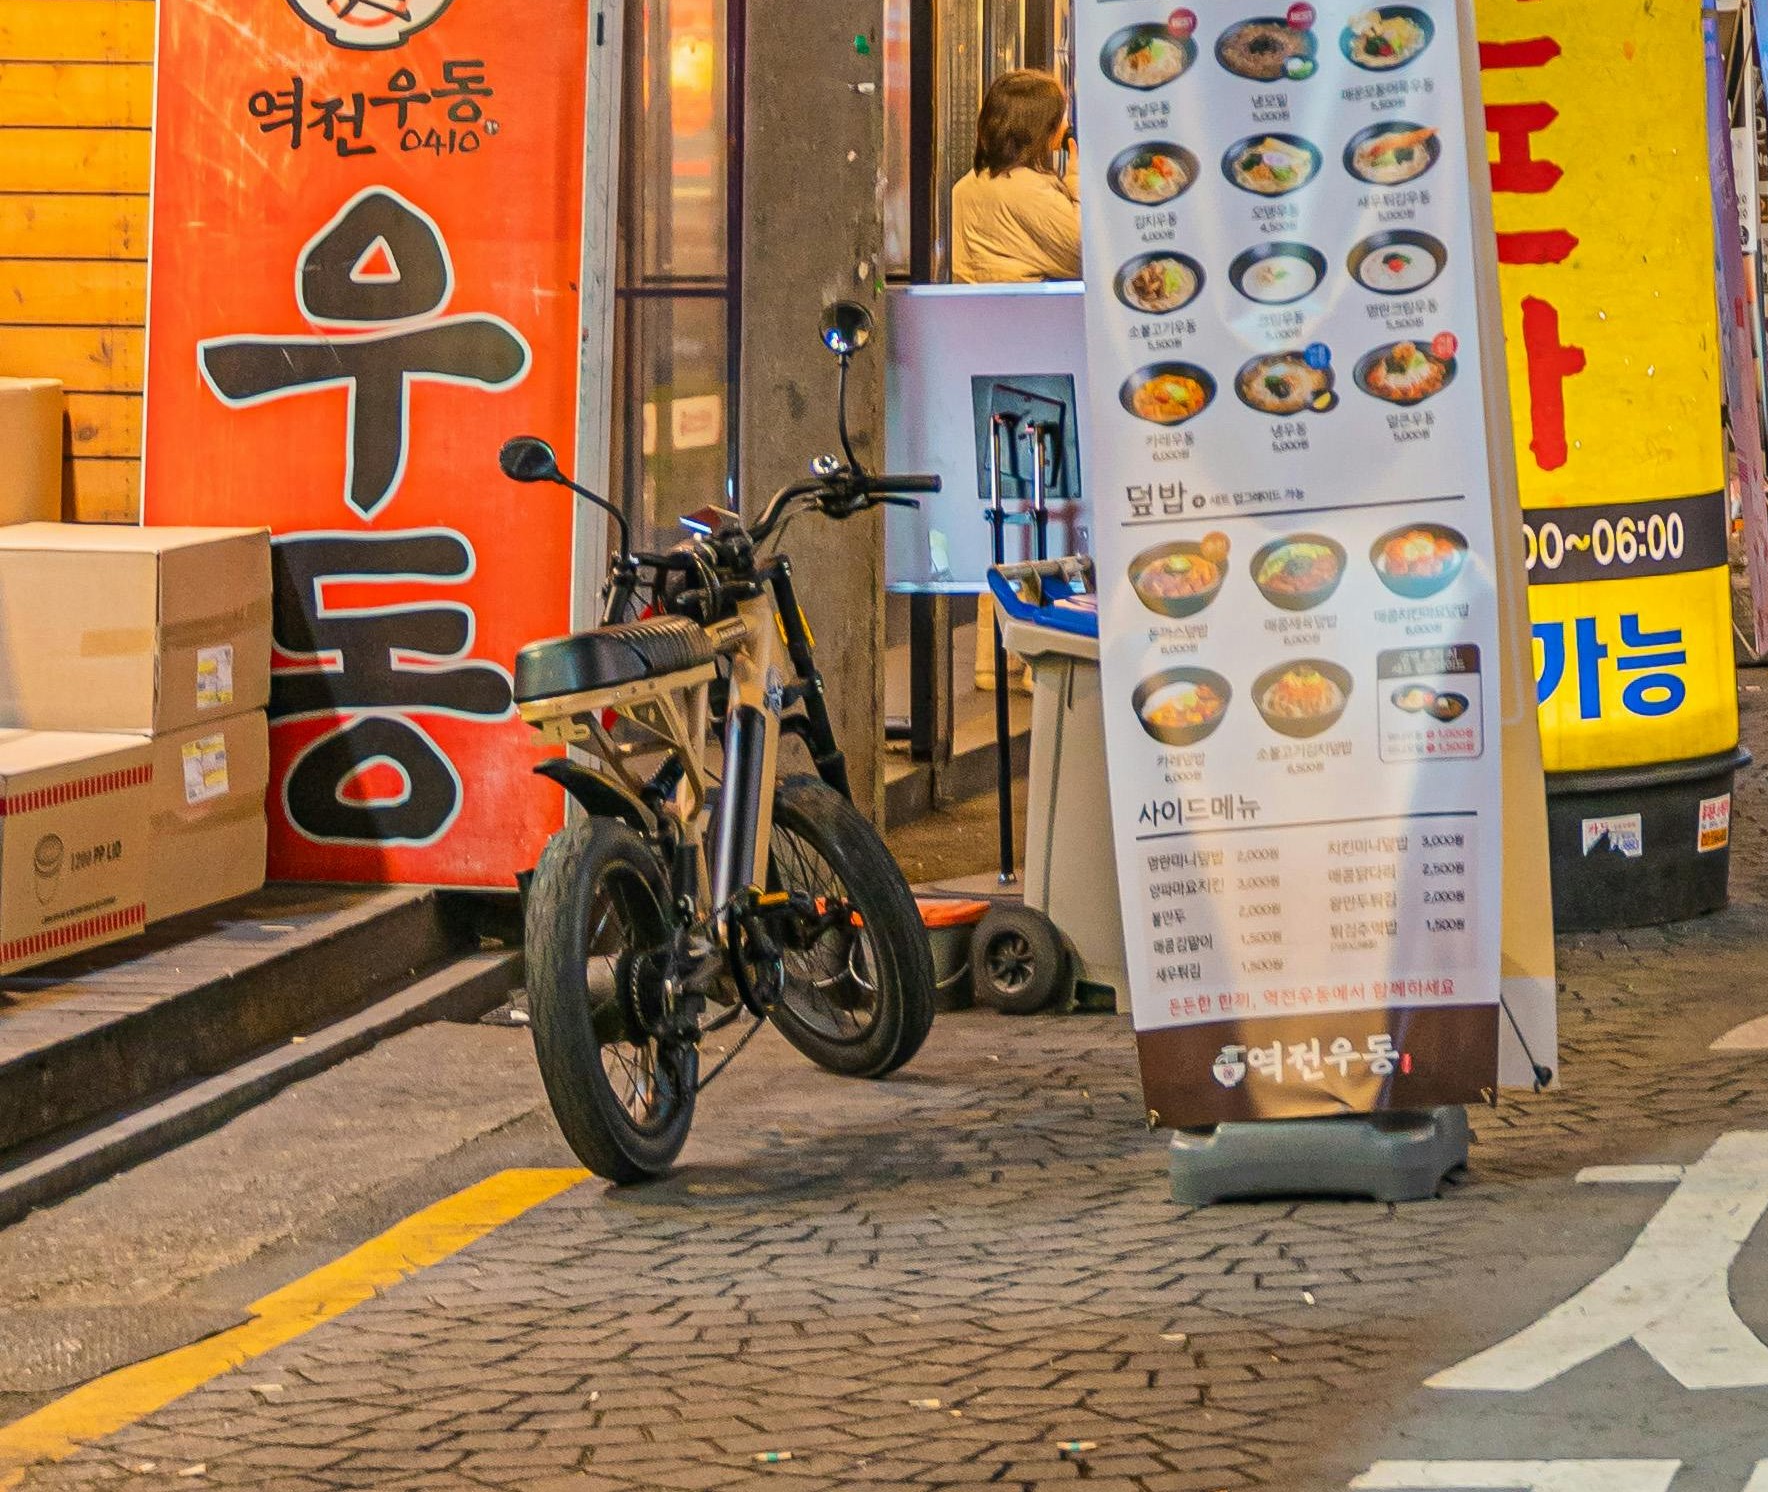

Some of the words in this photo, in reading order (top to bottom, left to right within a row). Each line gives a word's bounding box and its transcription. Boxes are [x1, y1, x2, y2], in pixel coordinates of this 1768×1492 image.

[247, 57, 494, 158] 역전우동
[399, 127, 480, 155] 0410
[196, 185, 533, 846] 우동
[1126, 478, 1189, 518] 덮밥
[1137, 793, 1262, 828] 사이드메뉴
[1246, 1031, 1400, 1085] 역전우동
